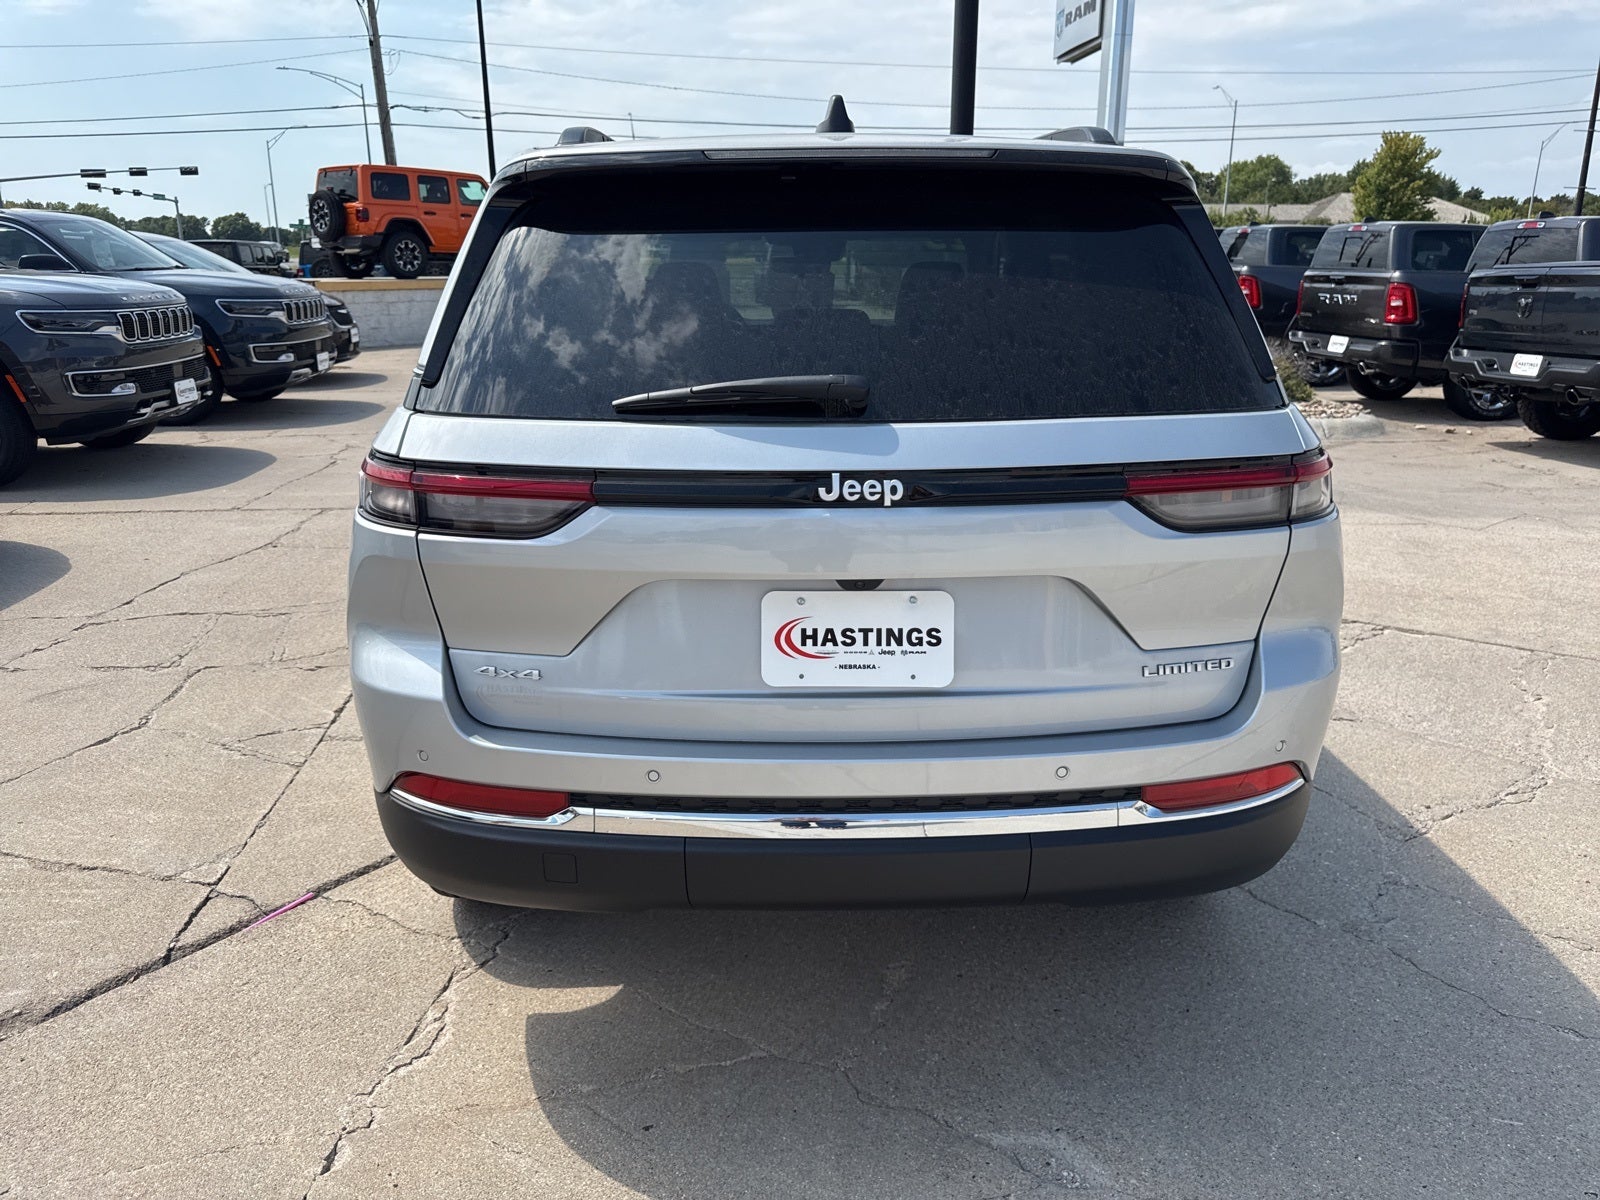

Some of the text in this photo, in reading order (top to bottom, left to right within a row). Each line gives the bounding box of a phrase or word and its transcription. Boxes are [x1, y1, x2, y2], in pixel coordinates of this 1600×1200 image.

[1065, 0, 1097, 28] RAM
[817, 472, 904, 507] Jeep
[800, 627, 943, 647] HASTINGS
[878, 648, 896, 656] Jeep
[473, 665, 543, 681] 4x4
[1142, 657, 1235, 678] LIMITED
